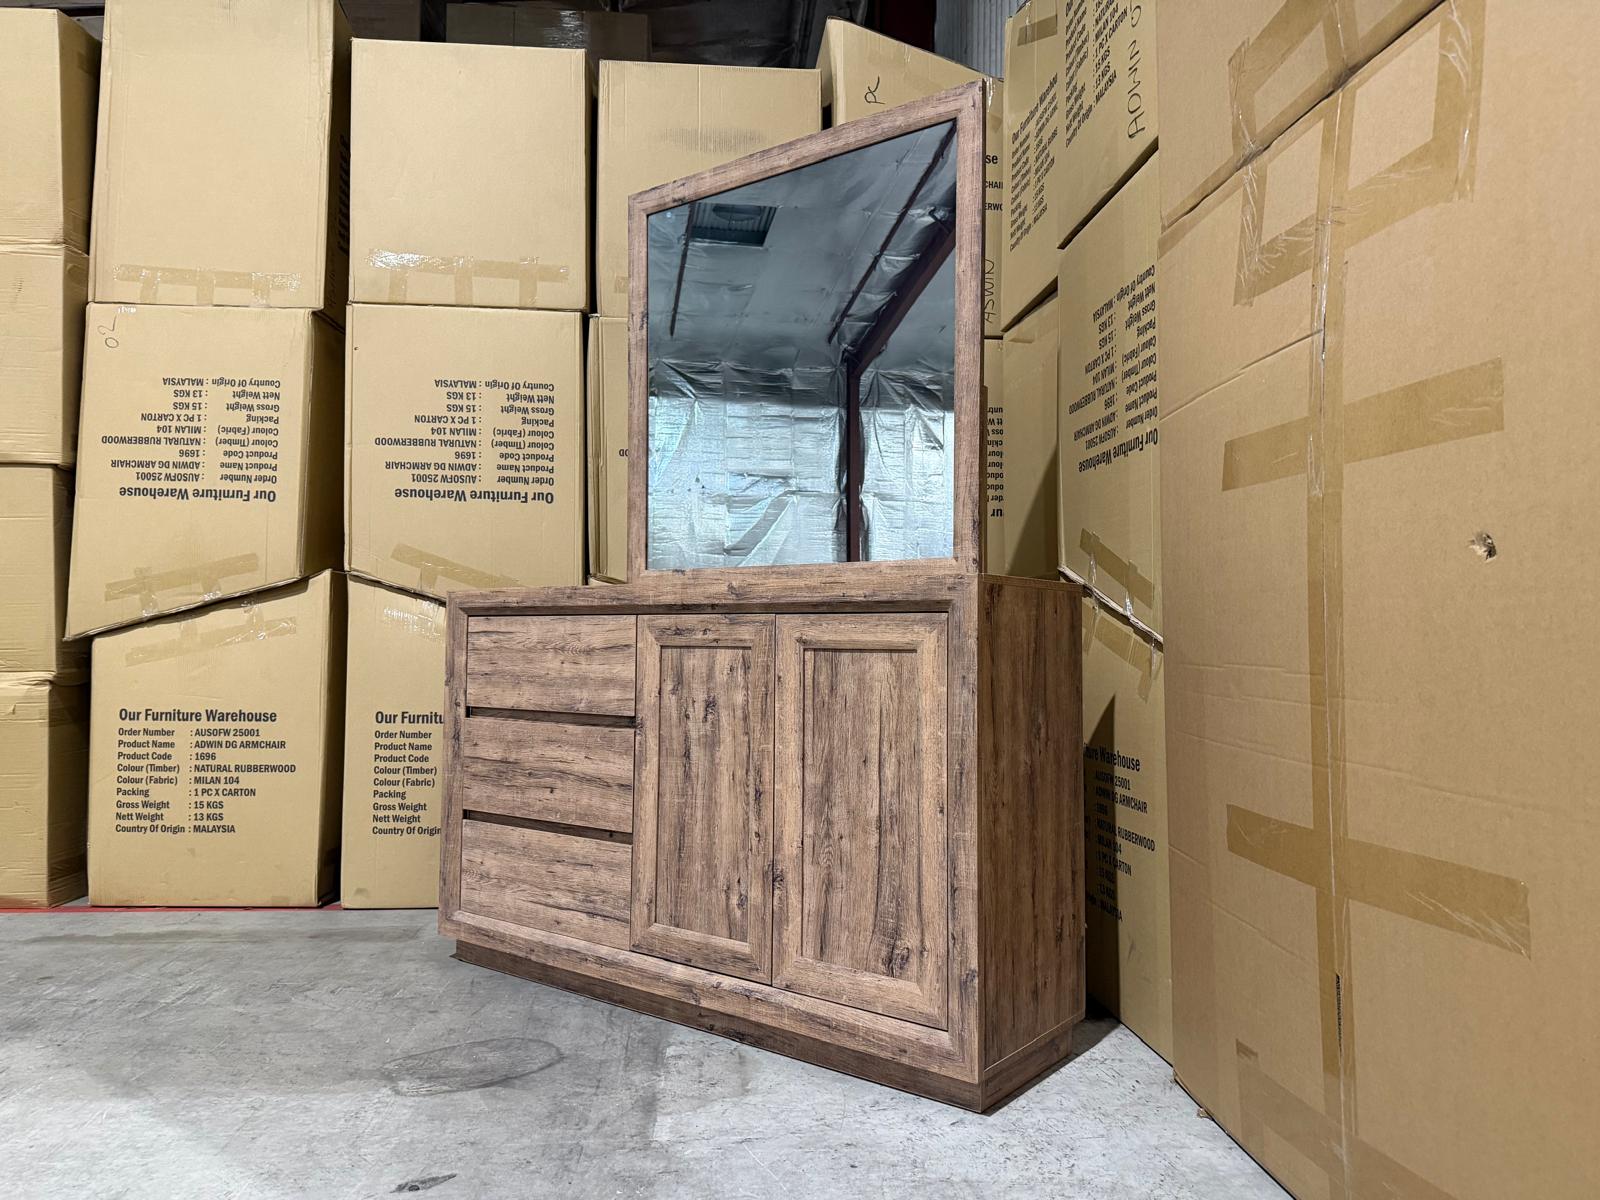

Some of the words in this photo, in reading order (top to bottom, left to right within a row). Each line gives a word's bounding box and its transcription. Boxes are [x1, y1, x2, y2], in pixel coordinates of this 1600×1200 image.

[162, 377, 204, 386] MALAYSIA
[212, 377, 236, 387] Origin
[237, 379, 247, 388] Of
[248, 378, 281, 389] Country
[434, 379, 477, 389] MALAYSIA
[485, 380, 510, 390] Origin
[511, 382, 521, 391] Of
[522, 381, 555, 392] Country
[173, 389, 190, 398] KGS
[192, 389, 203, 398] 13
[232, 389, 261, 400] Weight
[262, 391, 280, 401] Nett
[172, 402, 190, 410] KGS
[191, 402, 202, 411] 15
[226, 401, 255, 412] Weight
[256, 404, 280, 413] Gross
[141, 413, 175, 422] CARTON
[176, 414, 182, 422] X
[183, 413, 195, 422] PC
[197, 414, 202, 422] 1
[246, 413, 279, 425] Packing
[156, 425, 173, 434] 104
[174, 425, 202, 434] MILAN
[217, 425, 250, 436] (Fabric)
[251, 427, 279, 436] Colour
[431, 427, 447, 436] 104
[449, 427, 477, 437] MILAN
[493, 427, 526, 438] (Fabric)
[527, 430, 554, 439] Colour
[101, 435, 162, 445] RUBBERWOOD
[163, 437, 201, 446] NATURAL
[215, 436, 250, 447] (Timber)
[1145, 428, 1158, 445] Our
[251, 439, 278, 448] Colour
[374, 437, 436, 447] RUBBERWOOD
[438, 439, 477, 448] NATURAL
[491, 439, 526, 450] (Timber)
[527, 442, 555, 451] Colour
[1113, 434, 1143, 459] Furniture
[179, 449, 200, 458] 1696
[223, 450, 244, 459] Code
[245, 451, 278, 460] Product
[454, 451, 476, 460] 1696
[499, 452, 521, 461] Code
[522, 453, 554, 462] Product
[111, 459, 157, 469] ARMCHAIR
[158, 460, 170, 469] DG
[172, 461, 201, 470] ADWIN
[385, 461, 432, 470] ARMCHAIR
[1078, 449, 1112, 473] Warehouse
[220, 462, 244, 471] Name
[245, 462, 277, 472] Product
[433, 462, 446, 471] DG
[448, 463, 477, 471] ADWIN
[496, 464, 521, 473] Name
[522, 465, 554, 474] Product
[136, 472, 163, 481] 25001
[162, 472, 200, 482] AUSOFW
[219, 474, 252, 483] Number
[253, 474, 277, 484] Order
[411, 473, 439, 483] 25001
[440, 474, 477, 484] AUSOFW
[496, 476, 530, 486] Number
[531, 477, 554, 486] Order
[119, 487, 189, 500] Warehouse
[192, 488, 250, 502] Furniture
[253, 490, 276, 502] Our
[394, 488, 467, 502] Warehouse
[470, 490, 528, 503] Furniture
[532, 492, 554, 504] Our
[119, 708, 142, 721] Our
[144, 708, 202, 722] Furniture
[205, 709, 277, 722] Warehouse
[375, 711, 398, 724] Our
[401, 711, 445, 725] Furnitu
[118, 727, 142, 736] Order
[142, 728, 175, 737] Number
[194, 728, 232, 737] AUSOFW
[232, 728, 260, 737] 25001
[374, 730, 398, 739] Order
[399, 730, 432, 739] Number
[118, 739, 150, 748] Product
[151, 740, 175, 748] Name
[194, 740, 223, 749] ADWIN
[225, 740, 238, 749] DG
[239, 740, 286, 749] ARMCHAIR
[374, 742, 407, 751] Product
[408, 742, 432, 751] Name
[117, 751, 150, 760] Product
[151, 751, 172, 760] Code
[195, 752, 216, 761] 1696
[374, 754, 407, 763] Product
[408, 754, 429, 763] Code
[117, 763, 144, 772] Colour
[145, 763, 180, 774] (Timber)
[194, 764, 233, 773] NATURAL
[234, 764, 296, 773] RUBBERWOOD
[373, 766, 401, 775] Colour
[402, 766, 437, 776] (Timber)
[117, 775, 144, 784] Colour
[145, 775, 178, 786] (Fabric)
[194, 776, 221, 785] MILAN
[223, 776, 240, 785] 104
[373, 778, 401, 786] Colour
[402, 778, 435, 788] (Fabric)
[116, 787, 150, 798] Packing
[194, 788, 199, 797] 1
[201, 788, 213, 797] PC
[213, 788, 220, 797] X
[221, 788, 256, 797] CARTON
[373, 789, 407, 801] Packing
[116, 800, 140, 809] Gross
[141, 800, 170, 811] Weight
[194, 800, 205, 809] 15
[206, 800, 224, 809] KGS
[373, 802, 396, 811] Gross
[397, 802, 427, 813] Weight
[115, 812, 134, 821] Nett
[135, 812, 164, 823] Weight
[194, 812, 205, 821] 13
[206, 812, 224, 821] KGS
[372, 814, 391, 823] Nett
[391, 814, 421, 825] Weight
[115, 824, 148, 834] Country
[149, 824, 159, 833] Of
[160, 824, 185, 835] Origin
[193, 824, 236, 833] MALAYSIA
[372, 826, 405, 837] Country
[406, 826, 416, 835] Of
[417, 826, 442, 837] Origin
